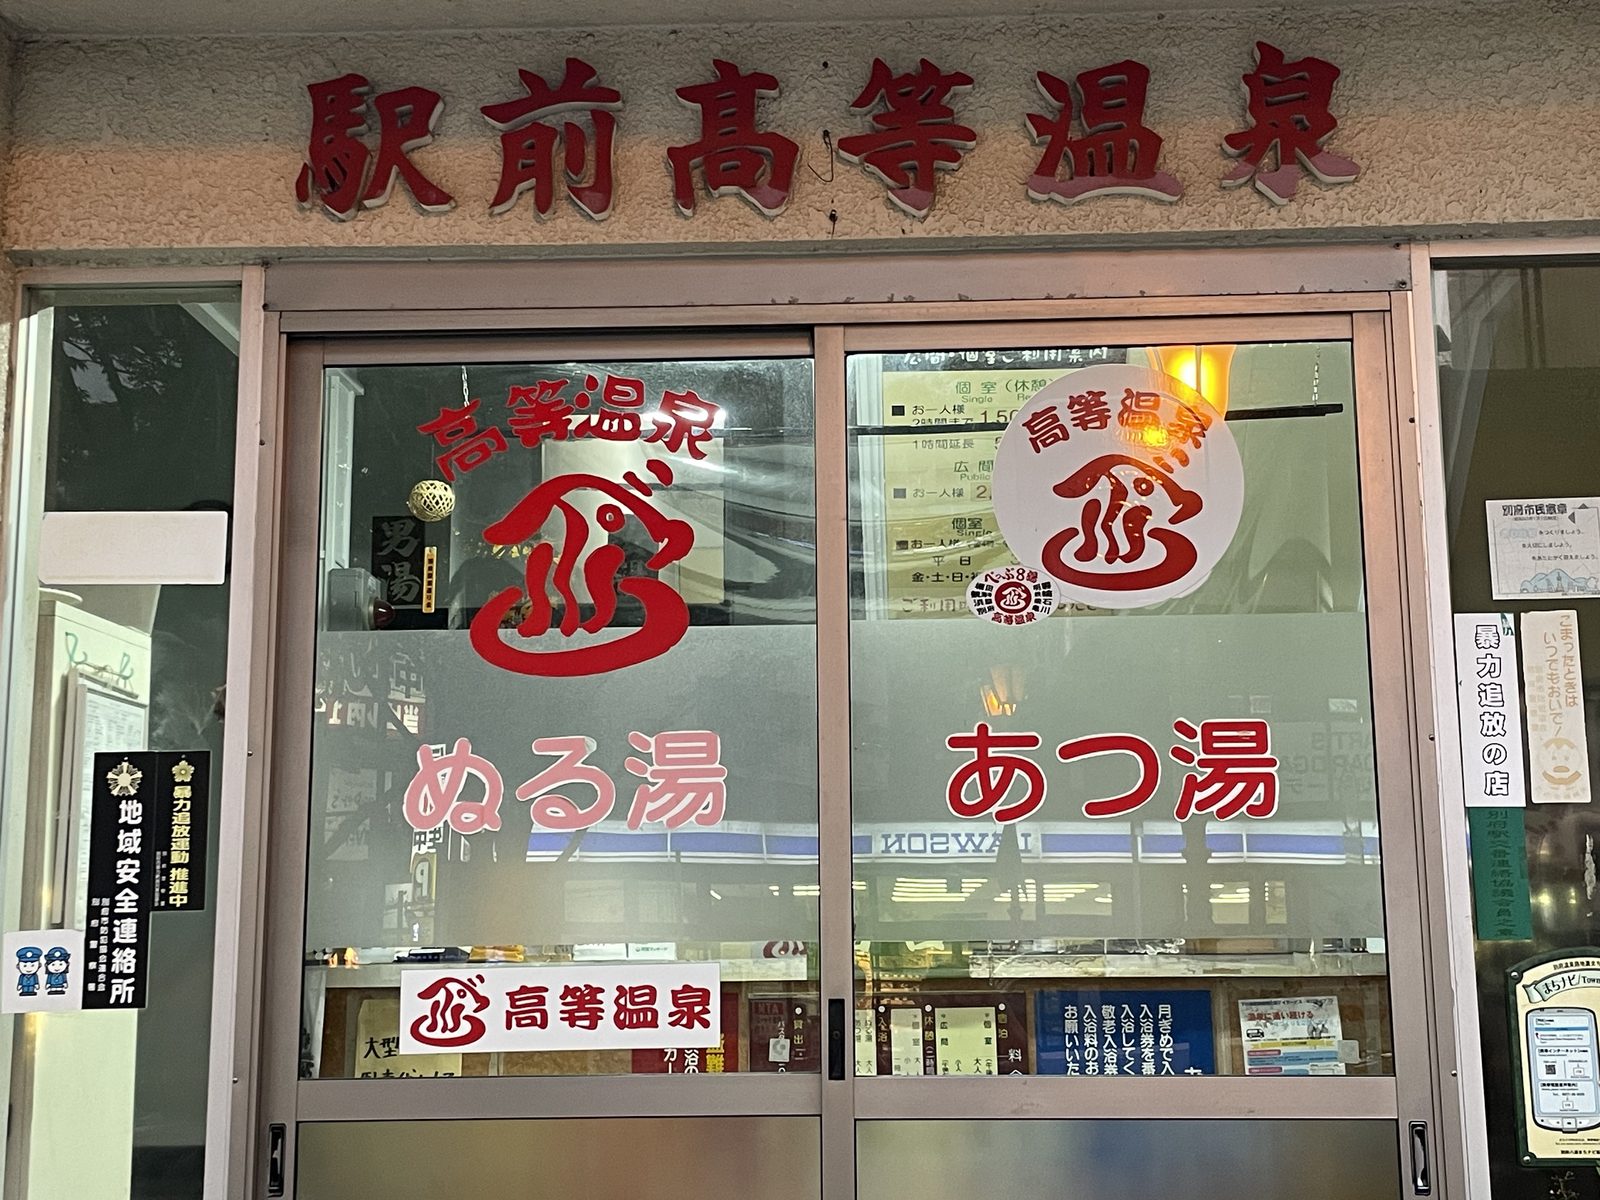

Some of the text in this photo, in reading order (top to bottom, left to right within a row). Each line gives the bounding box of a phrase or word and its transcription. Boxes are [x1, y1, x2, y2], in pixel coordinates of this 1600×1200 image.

[417, 374, 724, 482] 高等温泉
[961, 395, 993, 404] Single
[1474, 624, 1510, 797] 暴力追放の店
[403, 730, 728, 834] ぬる湯
[946, 717, 1280, 823] あつ湯
[109, 799, 143, 1005] 地域安全連絡所
[504, 983, 712, 1031] 高等温泉
[1083, 1003, 1099, 1076] 入浴料のお
[1120, 1003, 1135, 1076] 入浴してく
[1158, 1003, 1175, 1076] 月ぎめで入
